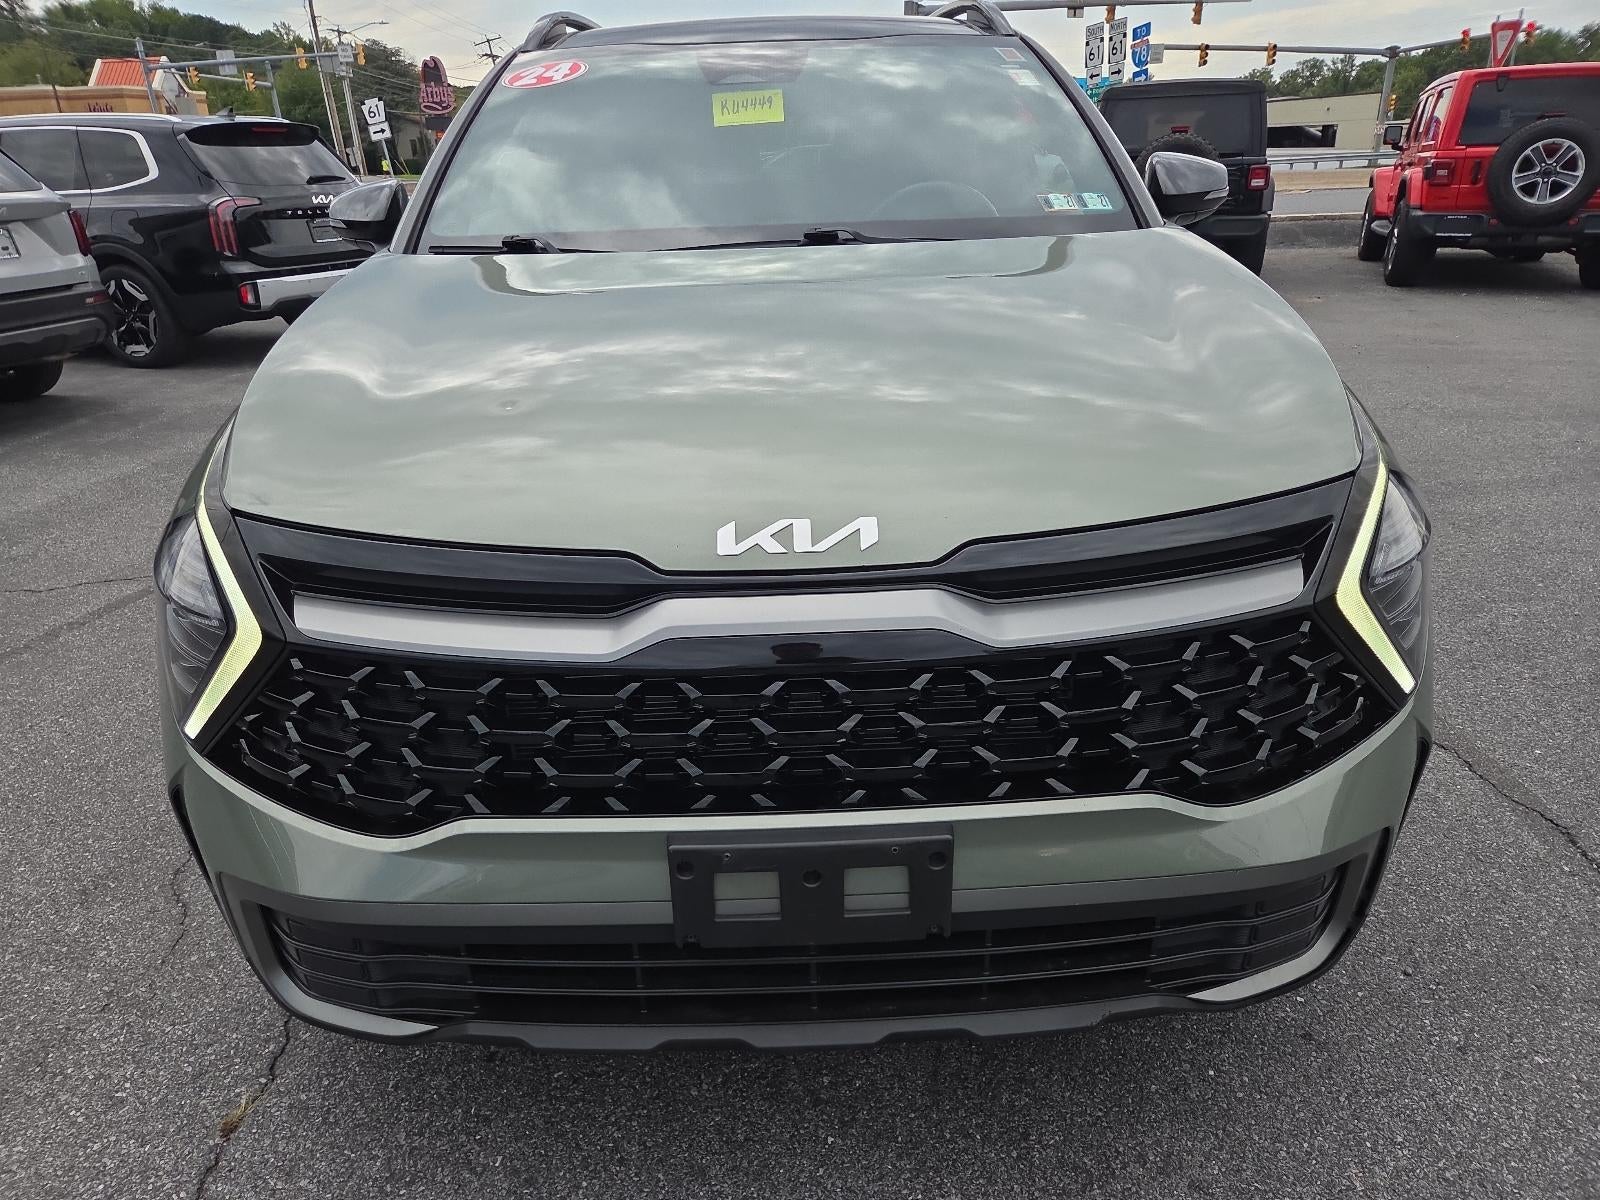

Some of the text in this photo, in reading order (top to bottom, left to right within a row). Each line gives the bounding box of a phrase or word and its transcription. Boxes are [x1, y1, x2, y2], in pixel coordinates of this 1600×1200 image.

[1087, 25, 1104, 38] SOUTH
[1137, 27, 1146, 37] TO
[1088, 45, 1100, 61] 61
[1111, 40, 1123, 56] 61
[1135, 46, 1147, 64] 78
[512, 62, 574, 86] 24
[368, 104, 381, 119] 61
[717, 516, 879, 556] KIA
